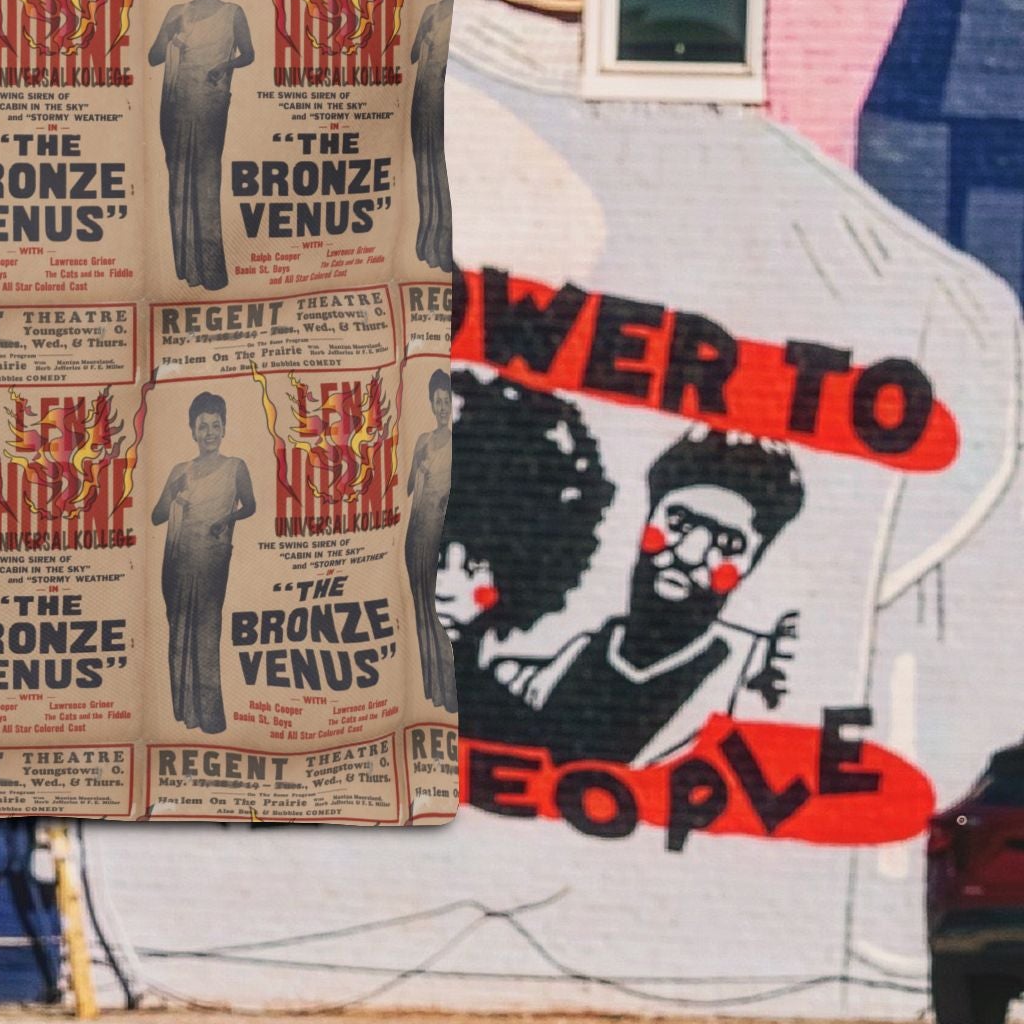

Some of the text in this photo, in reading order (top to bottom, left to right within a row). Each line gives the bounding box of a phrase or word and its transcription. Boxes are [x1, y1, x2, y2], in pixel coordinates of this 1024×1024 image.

[273, 66, 347, 87] UNIVERSAL
[27, 92, 54, 100] SIREN
[257, 91, 274, 99] THE
[278, 91, 307, 99] SWING
[45, 103, 62, 111] THE
[66, 103, 89, 111] SKY”
[279, 102, 367, 110] “CABIN IN THE SKY”
[26, 113, 69, 121] “STORMY
[74, 114, 123, 122] WEATHER”
[354, 112, 394, 120] WEATHER”
[272, 132, 359, 155] “THE
[231, 157, 392, 196] BRONZE
[240, 197, 392, 238] VENUS”
[302, 241, 323, 249] WITH
[19, 247, 44, 255] WITH
[50, 257, 88, 266] Lawrence
[45, 270, 57, 278] The
[60, 269, 79, 278] Cats
[109, 268, 133, 278] Fiddle
[2, 282, 13, 292] All
[15, 282, 33, 292] Star
[34, 282, 66, 291] Colored
[69, 282, 88, 291] Cast
[23, 310, 127, 324] THEATRE
[161, 292, 383, 334] REGENT THEATRE
[72, 338, 82, 348] &
[87, 337, 127, 347] Thurs.
[453, 266, 933, 455] WER TO
[26, 374, 67, 382] COMEDY
[274, 515, 347, 537] UNIVERSAL
[28, 555, 55, 563] SIREN
[59, 555, 72, 563] OF
[31, 566, 41, 574] IN
[67, 565, 90, 573] SKY”
[8, 576, 23, 584] and
[76, 574, 125, 582] WEATHER”
[49, 585, 58, 593] IN
[273, 576, 348, 601] “THE
[231, 598, 394, 646] BRONZE
[239, 642, 396, 691] VENUS”
[303, 696, 327, 705] WITH
[22, 751, 124, 765] THEATRE
[158, 740, 389, 780] REGENT THEATRE
[467, 706, 881, 853] EOPLE
